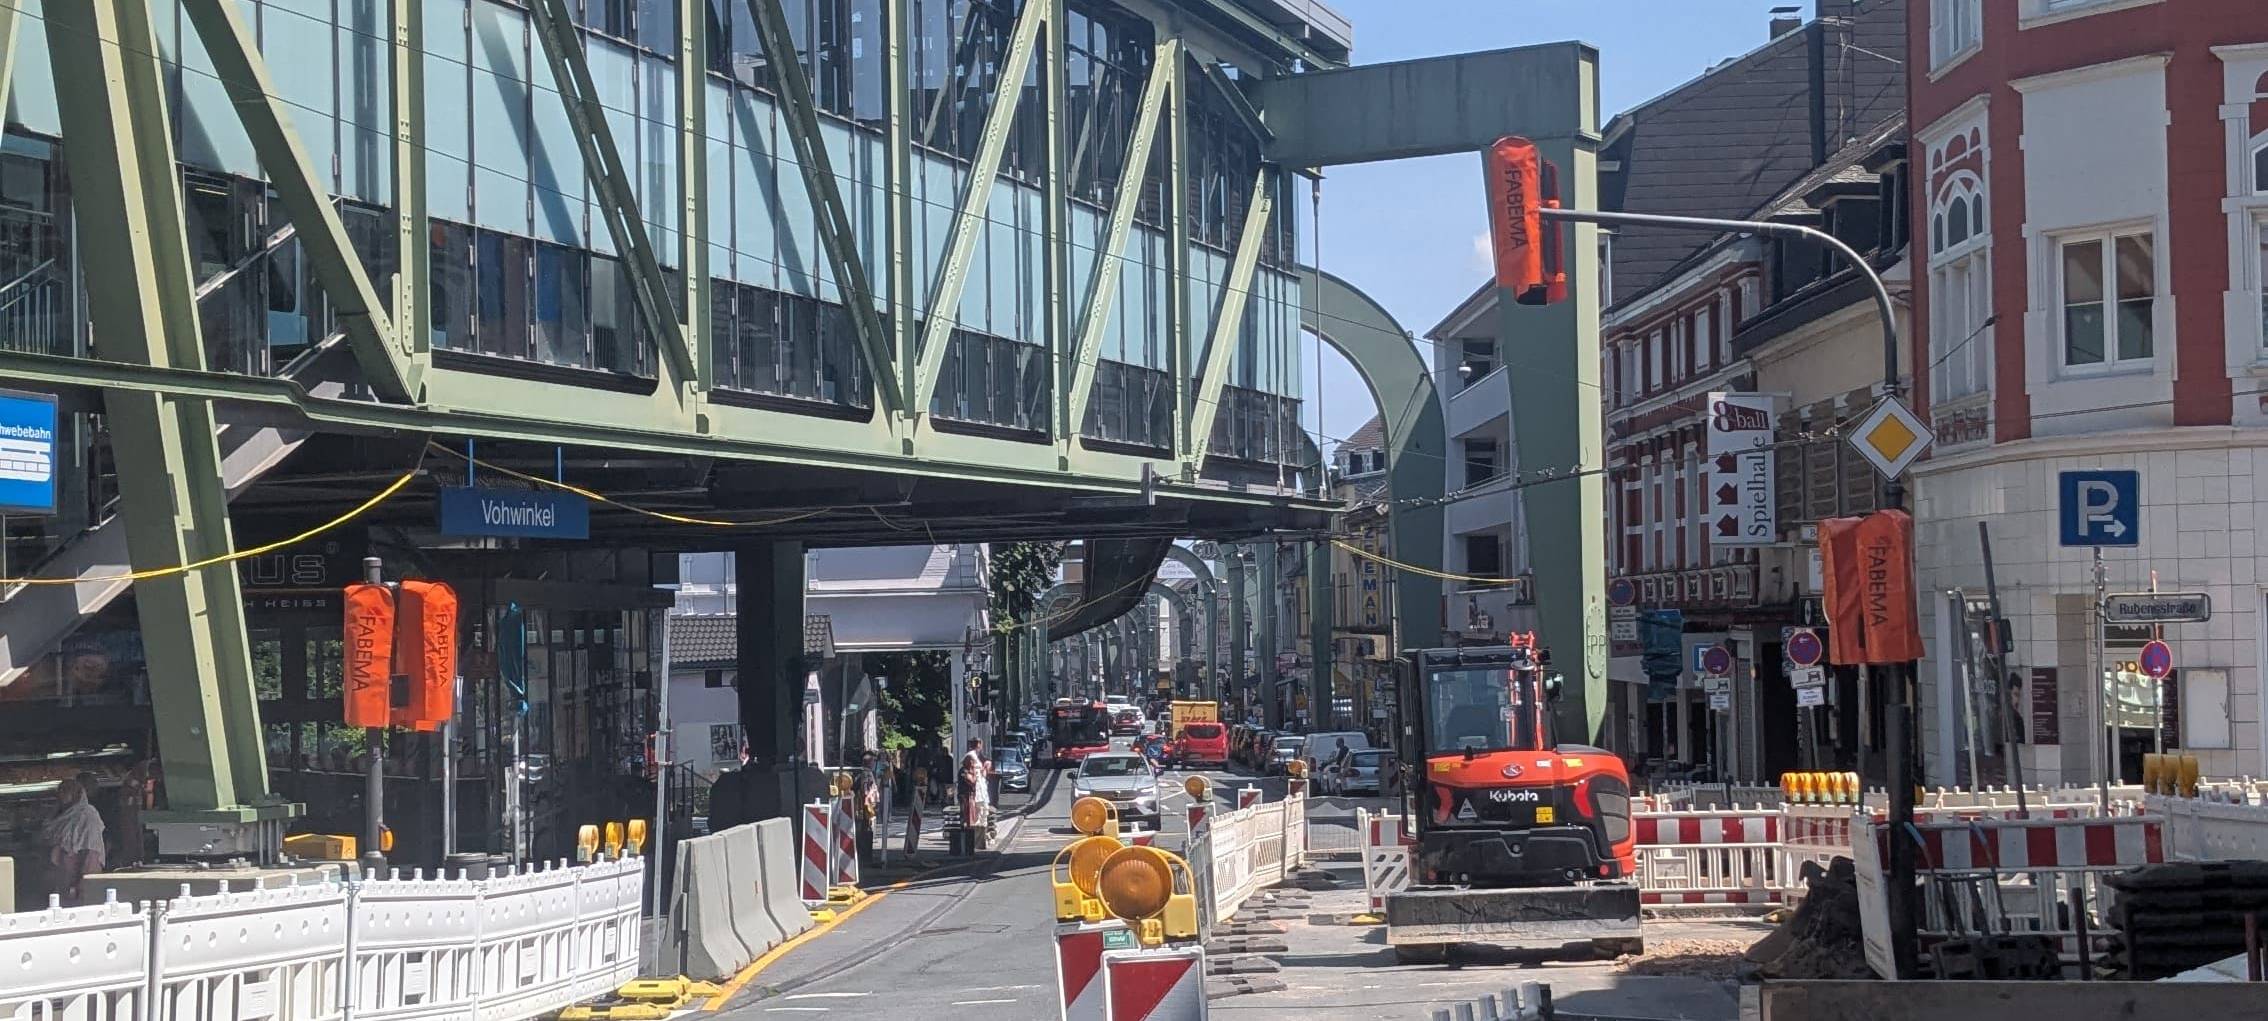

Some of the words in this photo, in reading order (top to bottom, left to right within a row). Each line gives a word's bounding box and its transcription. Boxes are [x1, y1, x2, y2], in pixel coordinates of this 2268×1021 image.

[1504, 168, 1529, 250] FABEMA
[481, 498, 556, 528] Vohwinkel
[1746, 436, 1771, 538] Spielhale
[2077, 480, 2119, 537] P
[1867, 546, 1889, 627] FABEMA
[2119, 602, 2197, 616] Rubensstraße
[352, 615, 377, 693] FABEMA
[435, 613, 449, 687] FABEMA
[1489, 789, 1540, 802] Kubota
